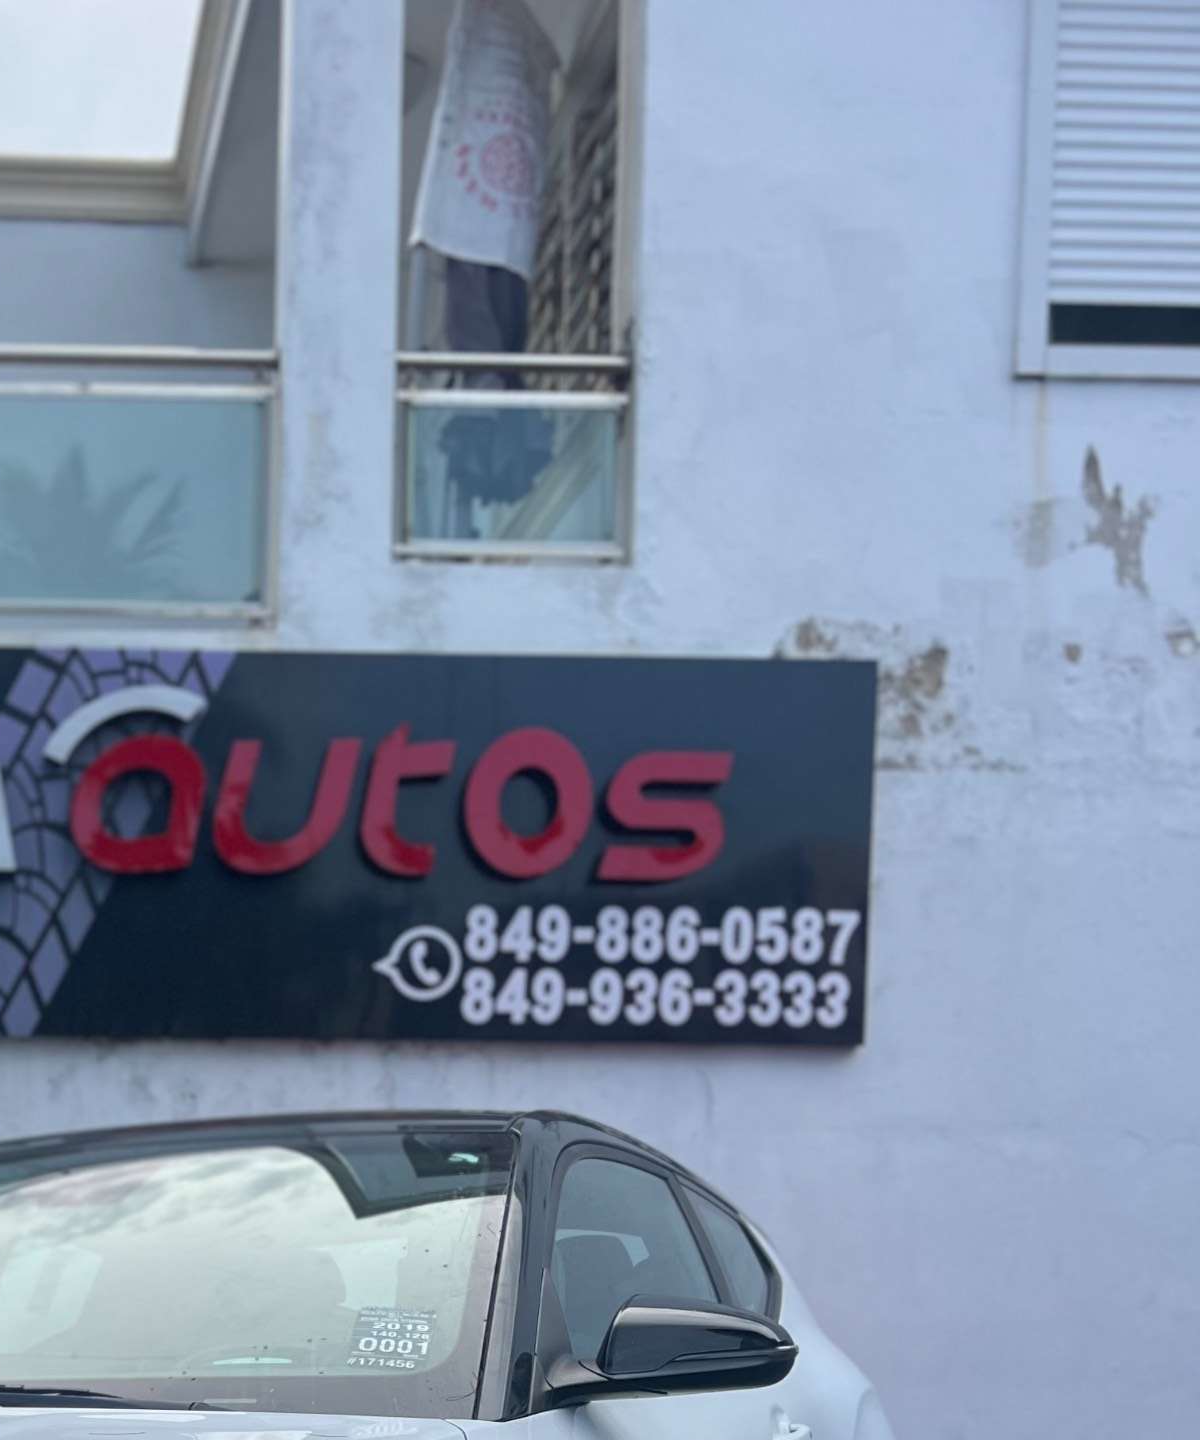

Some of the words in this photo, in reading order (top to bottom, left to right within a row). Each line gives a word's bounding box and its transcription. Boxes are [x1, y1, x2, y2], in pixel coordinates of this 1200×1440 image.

[465, 903, 861, 965] 849-886-0587
[460, 968, 850, 1030] 849-936-3333
[373, 1322, 430, 1332] 2019
[358, 1337, 429, 1355] 0001
[346, 1357, 416, 1369] #171456
